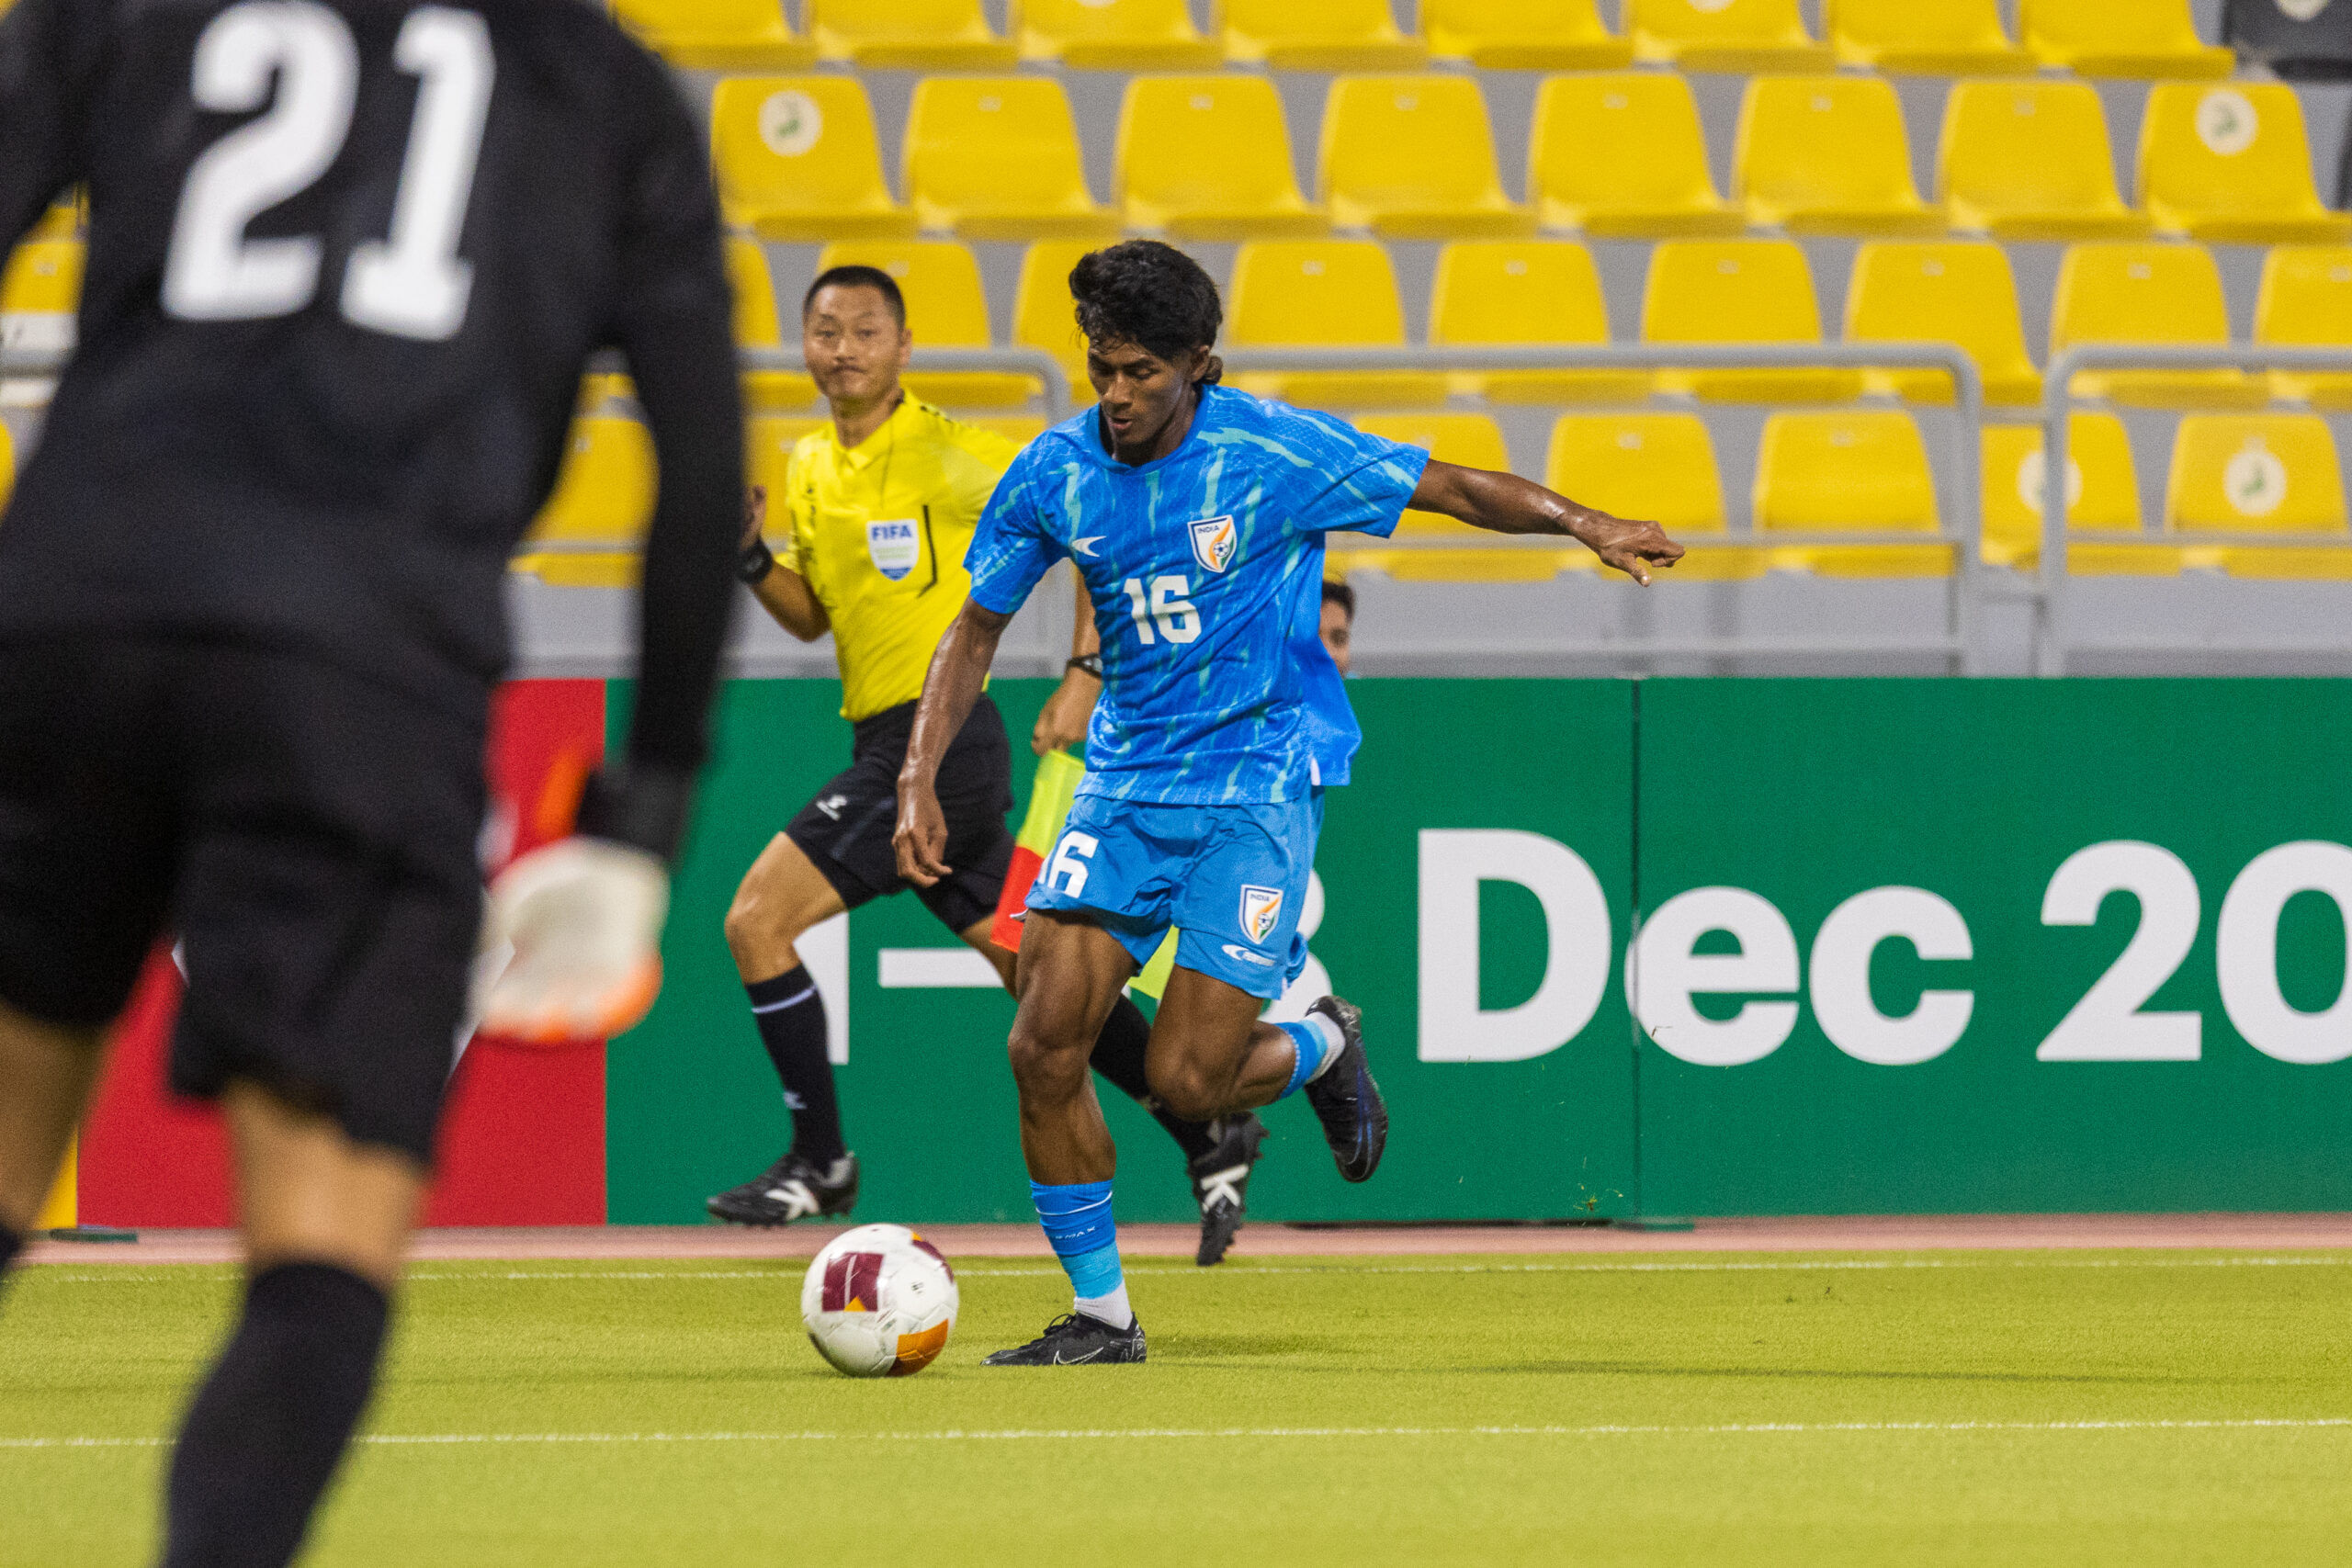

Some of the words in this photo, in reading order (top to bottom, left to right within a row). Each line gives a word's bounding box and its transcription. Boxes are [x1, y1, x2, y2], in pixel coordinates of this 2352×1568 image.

[164, 0, 495, 340] 21
[871, 525, 912, 540] FIFA
[1123, 575, 1202, 644] 16
[1418, 828, 1974, 1066] Dec
